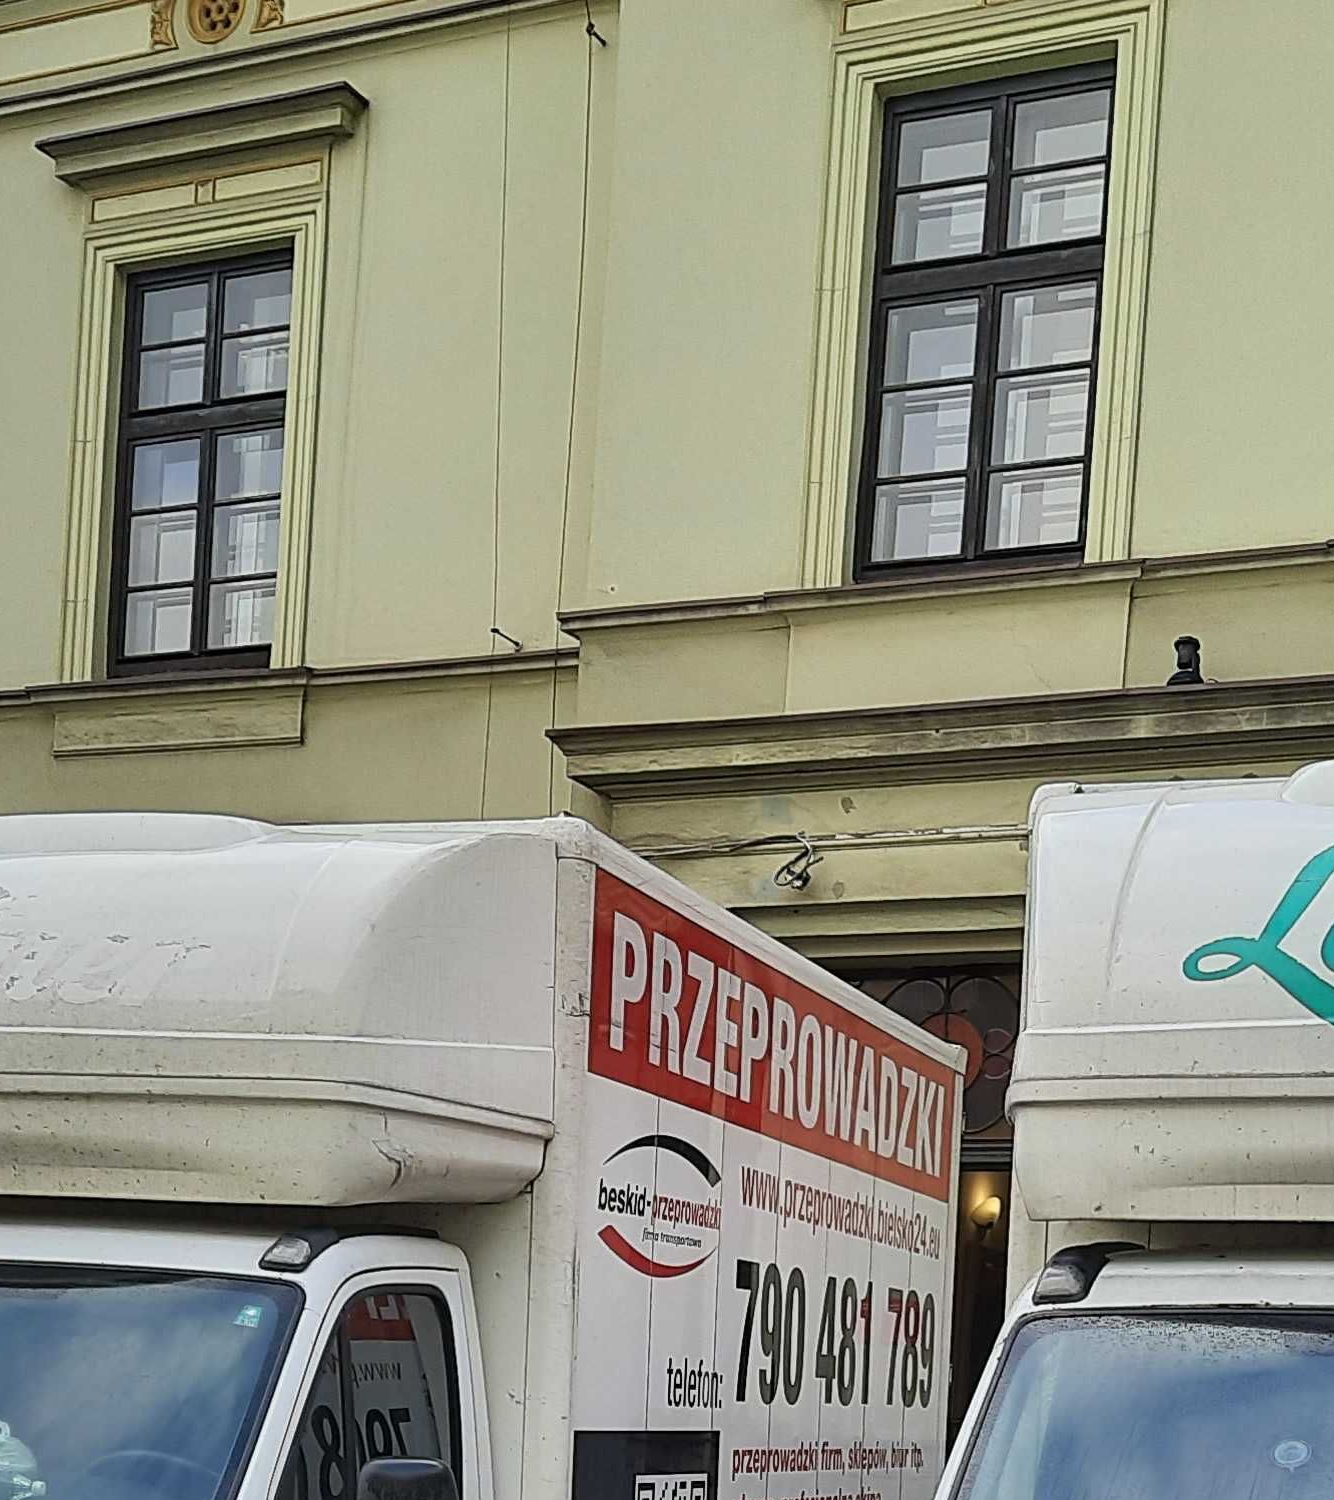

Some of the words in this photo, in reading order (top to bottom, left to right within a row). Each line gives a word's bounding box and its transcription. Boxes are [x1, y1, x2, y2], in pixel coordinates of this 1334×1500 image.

[610, 911, 946, 1178] PRZEPROWADZKI
[598, 1178, 721, 1230] beskid-przeprowadzki
[741, 1166, 941, 1260] www.przeprowadzki.bielsko24.eu
[667, 1357, 723, 1408] telefon:
[736, 1259, 806, 1405] 790
[815, 1276, 872, 1406] 481
[886, 1287, 935, 1408] 789
[731, 1441, 819, 1481] przeprowadzki
[821, 1442, 845, 1475] firm,
[848, 1441, 889, 1475] sklepów,
[891, 1441, 908, 1468] biur
